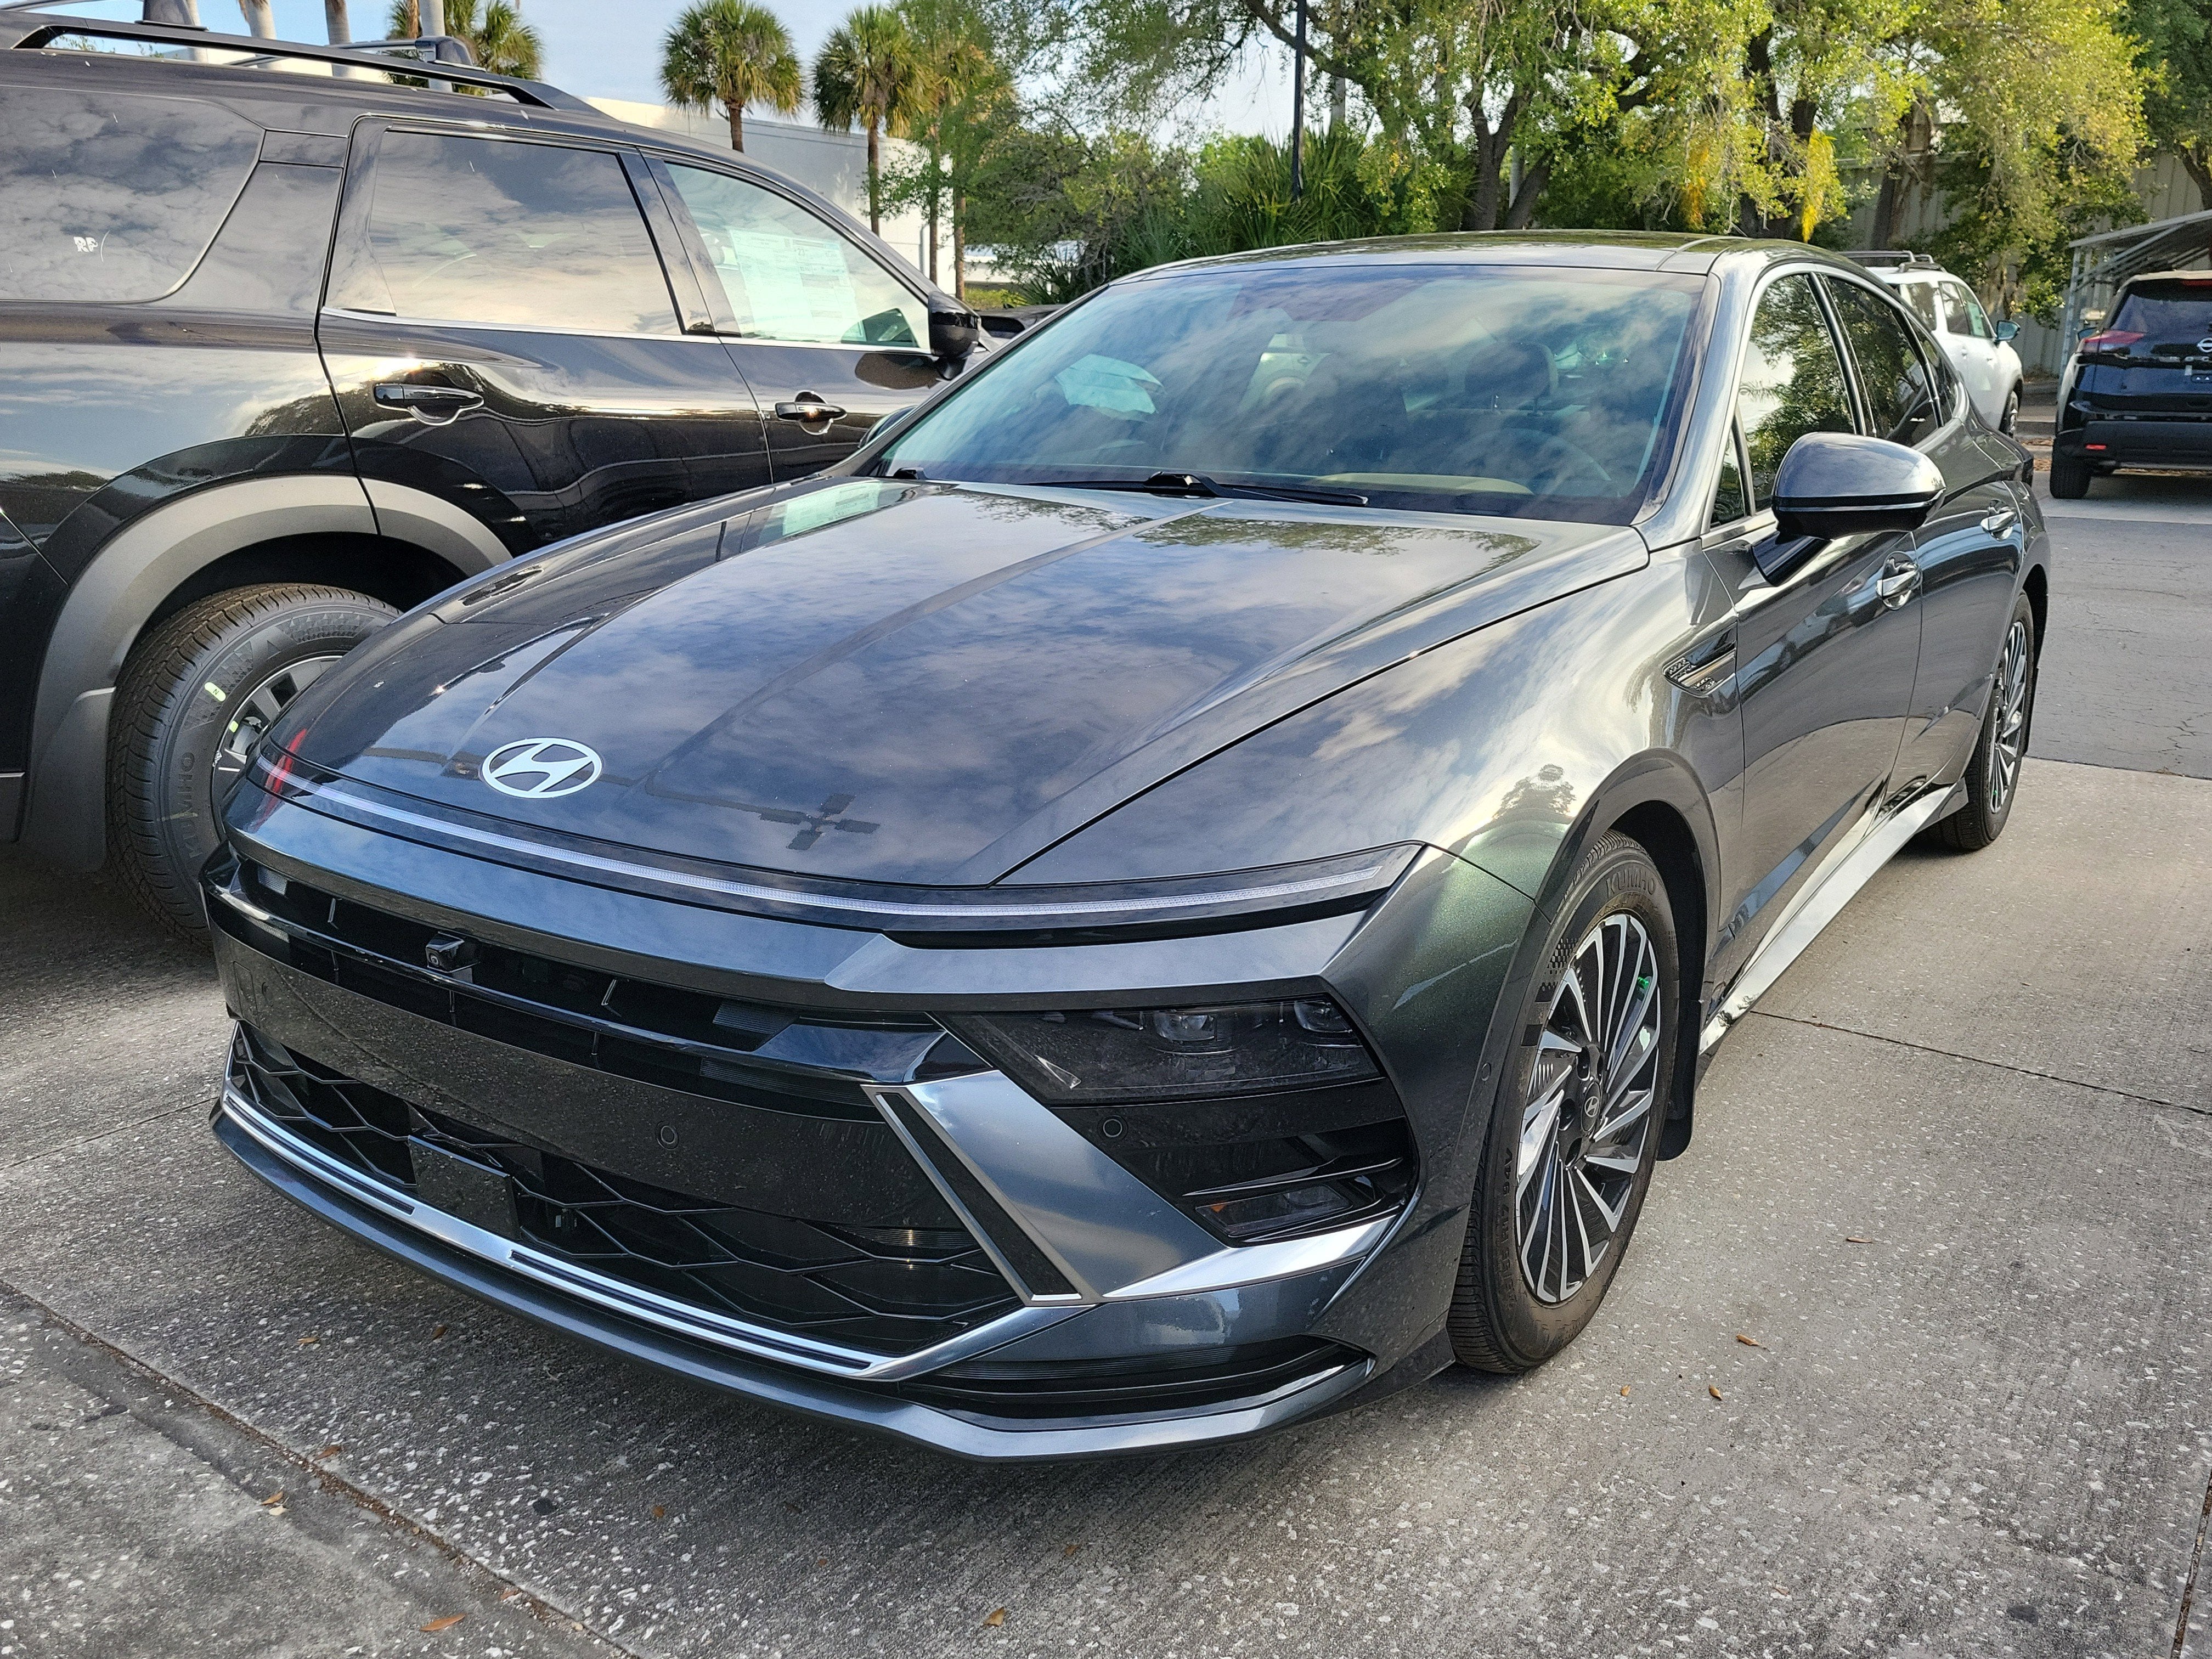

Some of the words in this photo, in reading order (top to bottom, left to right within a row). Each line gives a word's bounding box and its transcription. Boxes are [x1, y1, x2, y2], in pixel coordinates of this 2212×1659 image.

[177, 752, 203, 858] KUMHO
[1605, 868, 1655, 898] KUMHO
[1503, 1148, 1513, 1195] 94V
